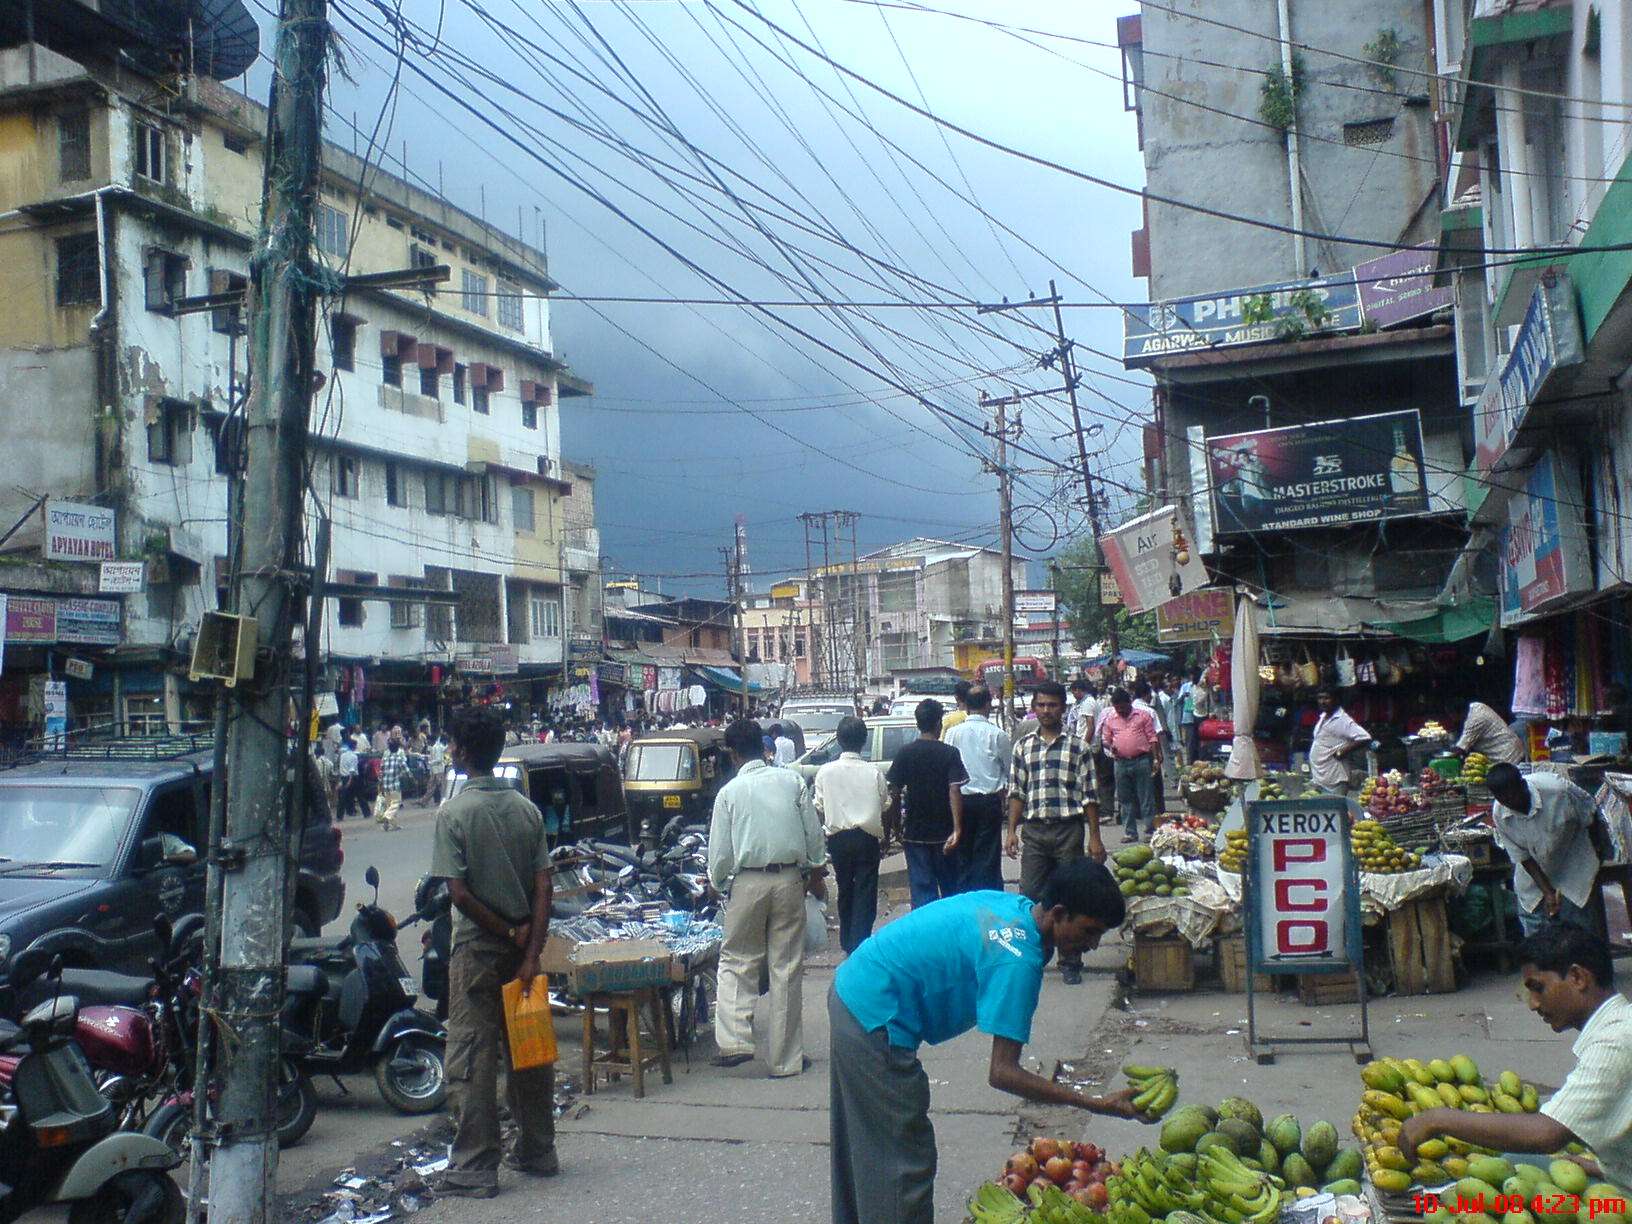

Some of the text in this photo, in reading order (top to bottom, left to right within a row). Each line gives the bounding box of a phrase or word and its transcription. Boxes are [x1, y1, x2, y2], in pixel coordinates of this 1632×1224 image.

[1142, 333, 1212, 353] AGARWAL
[1225, 325, 1275, 343] MUSIC
[1274, 473, 1386, 499] MASTERSTROKE
[1262, 509, 1383, 530] STANDARD WINE SHOP
[1137, 532, 1158, 553] Air
[1263, 814, 1337, 833] XEROX
[1273, 838, 1329, 953] PCO
